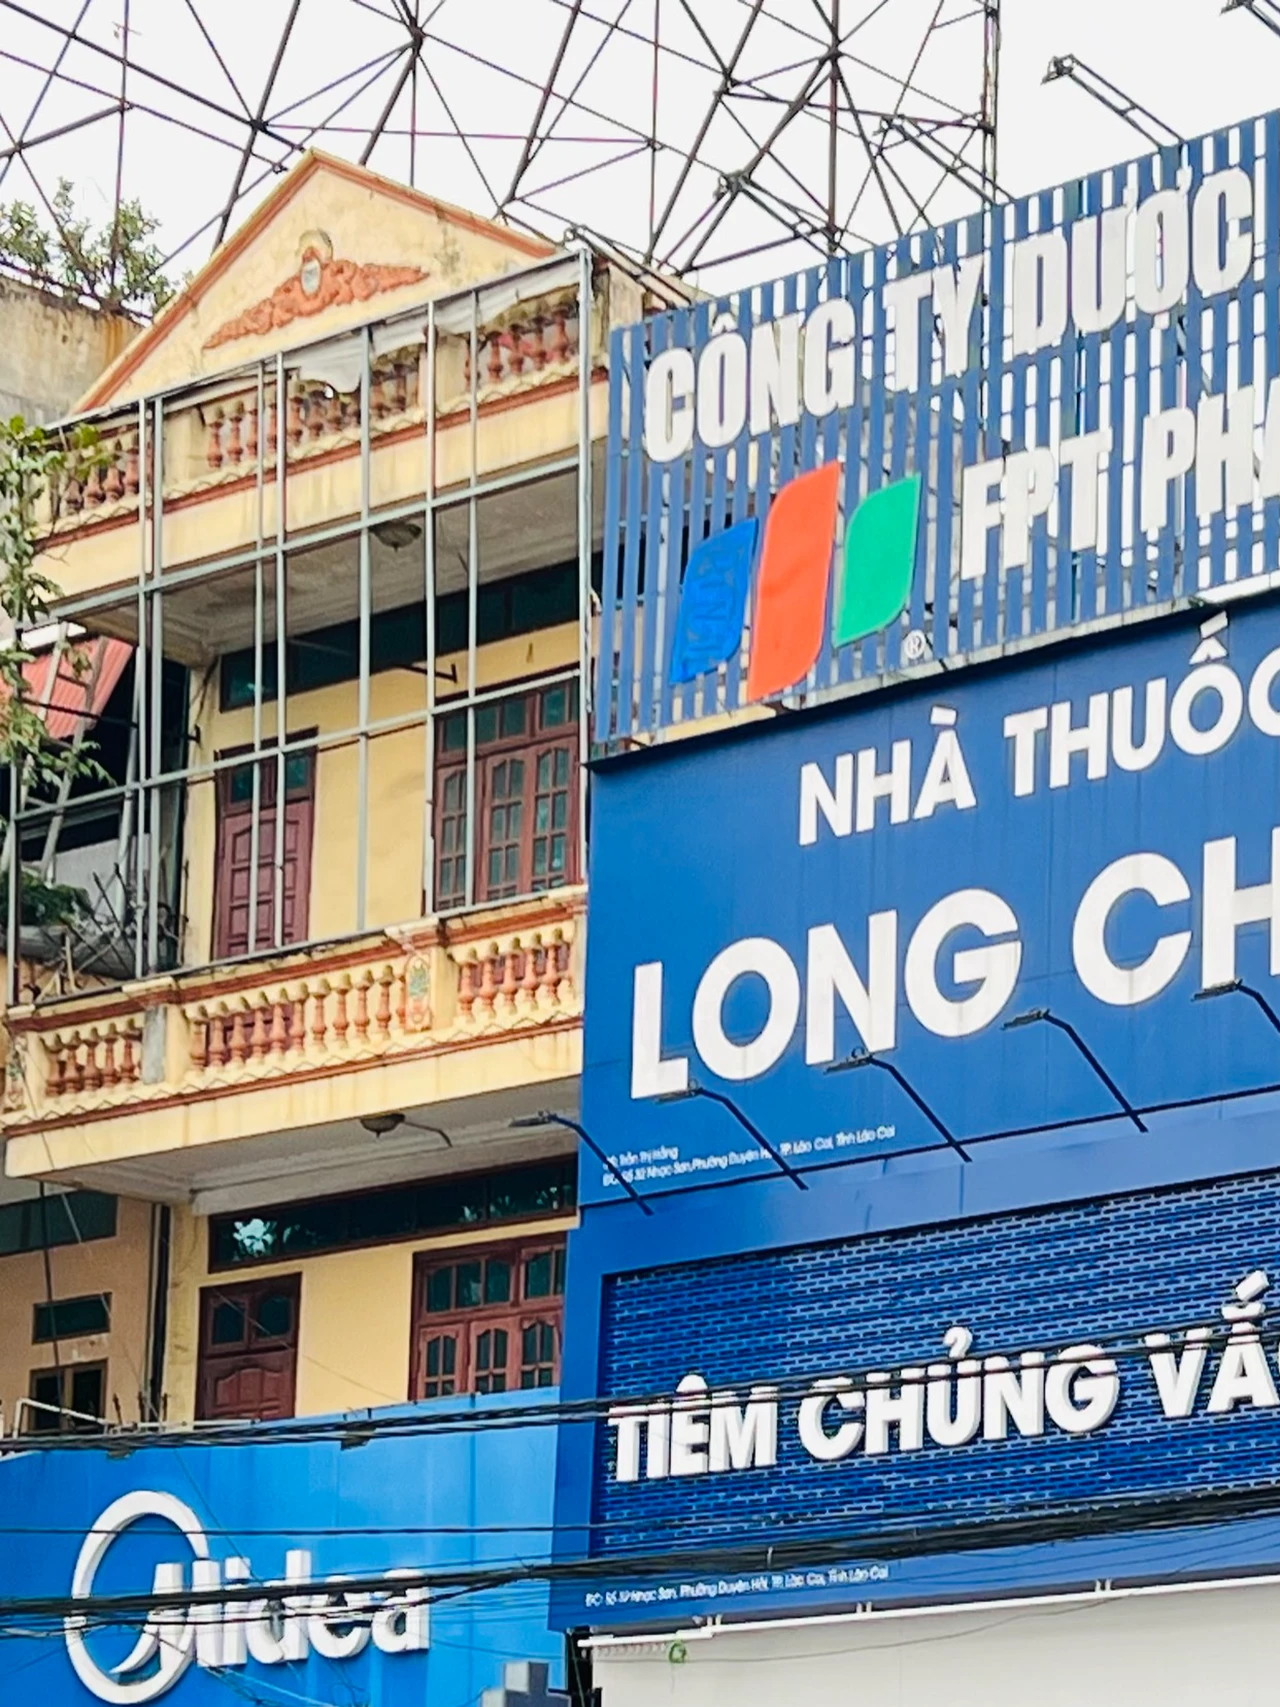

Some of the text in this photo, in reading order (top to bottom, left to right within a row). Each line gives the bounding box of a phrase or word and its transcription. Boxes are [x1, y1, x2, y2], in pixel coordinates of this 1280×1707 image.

[645, 298, 856, 463] CÔNG
[882, 255, 986, 394] TY
[1012, 165, 1254, 357] DƯỢC
[962, 429, 1111, 580] FPT
[800, 705, 977, 846] NHÀ
[630, 889, 1022, 1099] LONG
[608, 1373, 778, 1482] TIÊM
[798, 1326, 1120, 1462] CHỦNG
[64, 1490, 430, 1704] Midea
